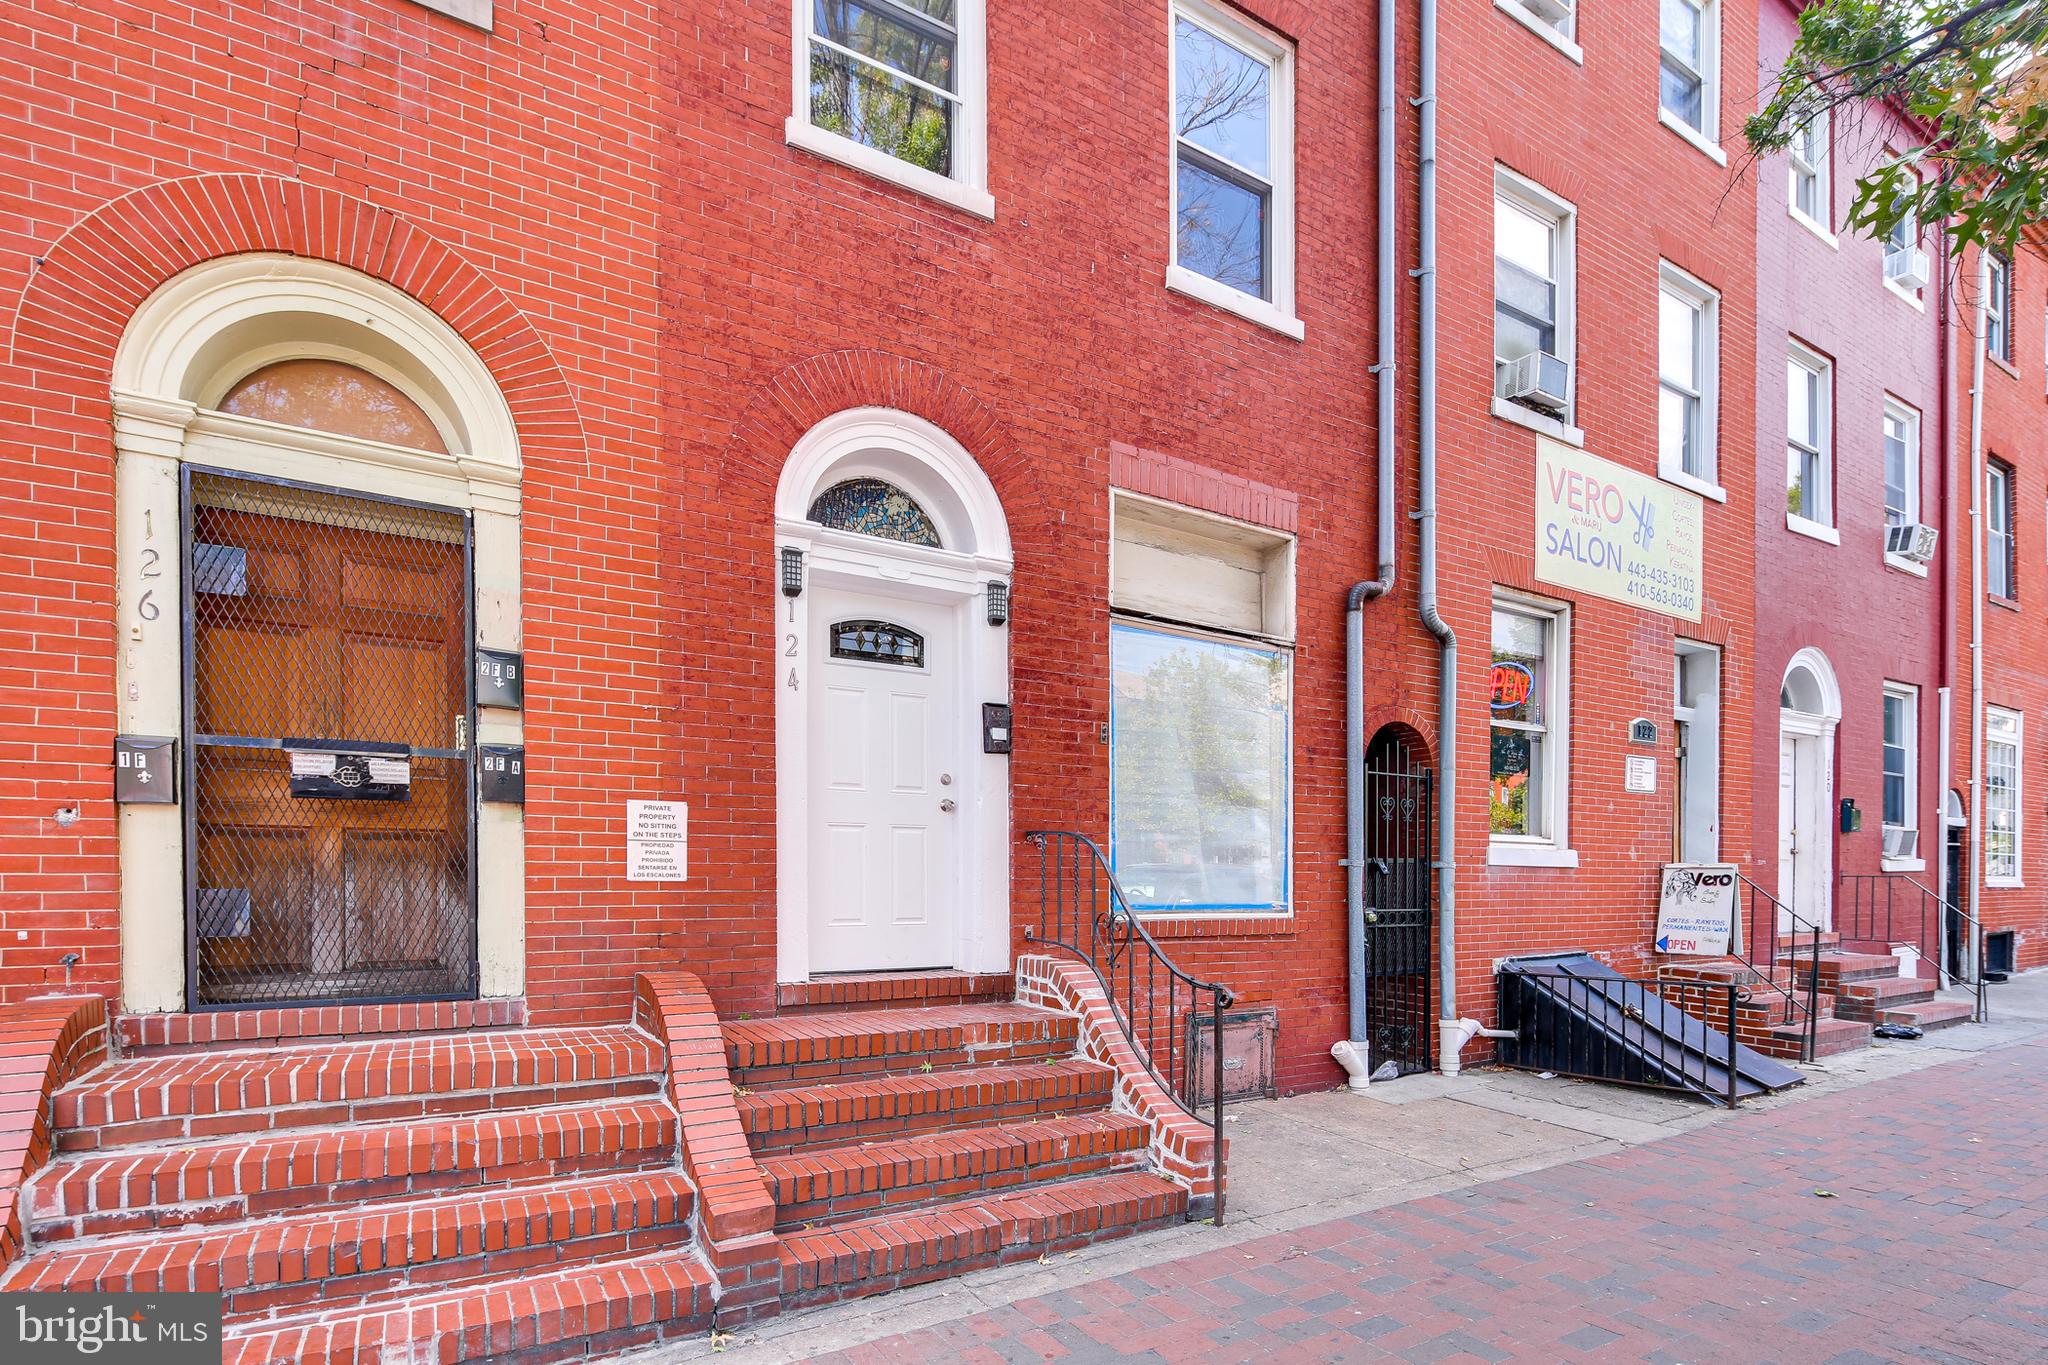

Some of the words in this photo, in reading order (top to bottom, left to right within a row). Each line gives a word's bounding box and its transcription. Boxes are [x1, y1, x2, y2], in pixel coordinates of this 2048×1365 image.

[1545, 461, 1624, 524] VERO
[1546, 522, 1622, 573] SALON
[138, 508, 161, 620] 126
[1627, 561, 1695, 593] 443-435-3103
[1627, 580, 1694, 612] 410-563-0340
[785, 599, 799, 691] 124
[1491, 667, 1530, 705] PEN
[1637, 725, 1653, 738] 122
[643, 804, 672, 812] PRIVATE
[650, 822, 677, 830] SITTING
[1690, 872, 1733, 887] Vero
[1667, 939, 1697, 951] OPEN
